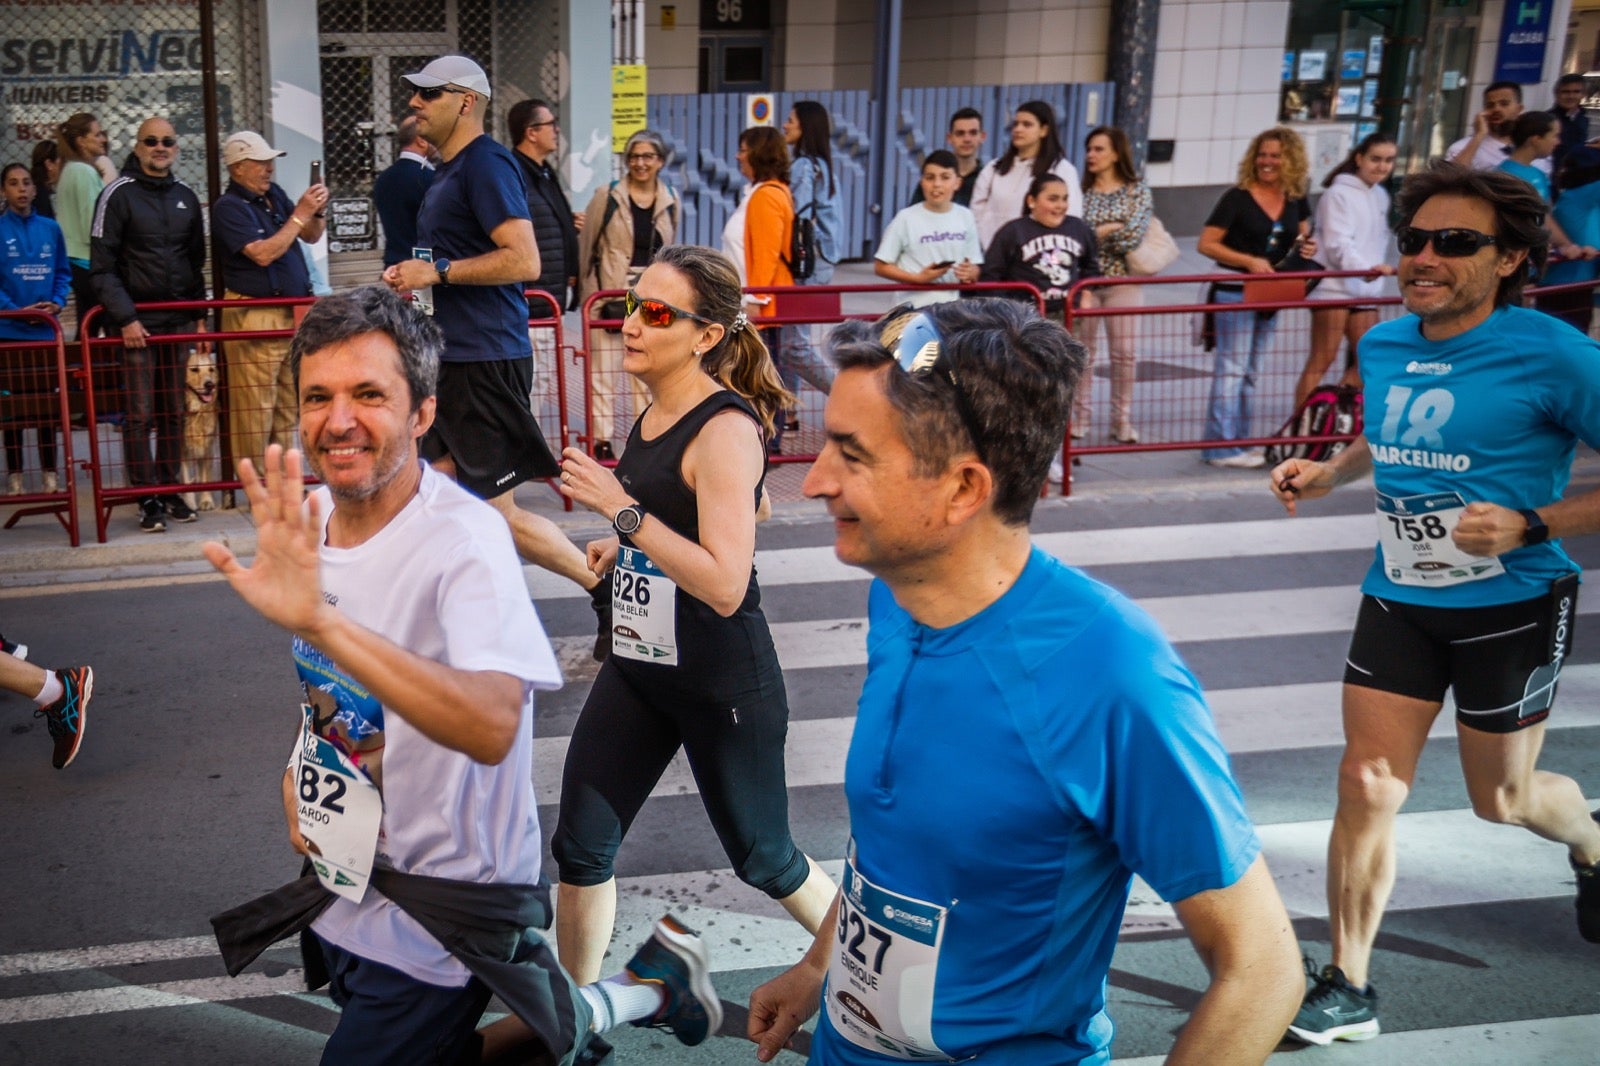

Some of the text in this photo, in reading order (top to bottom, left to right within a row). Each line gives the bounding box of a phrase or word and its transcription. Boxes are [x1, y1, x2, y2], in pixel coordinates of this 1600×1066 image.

[716, 0, 743, 22] 96
[1380, 384, 1456, 450] 18
[1368, 442, 1471, 473] MARCELINO
[1387, 514, 1447, 542] 758
[613, 568, 651, 606] 926
[626, 605, 649, 618] BELÉN
[298, 805, 330, 825] ARDO
[838, 896, 892, 975] 927
[841, 951, 880, 991] ENRIQUE
